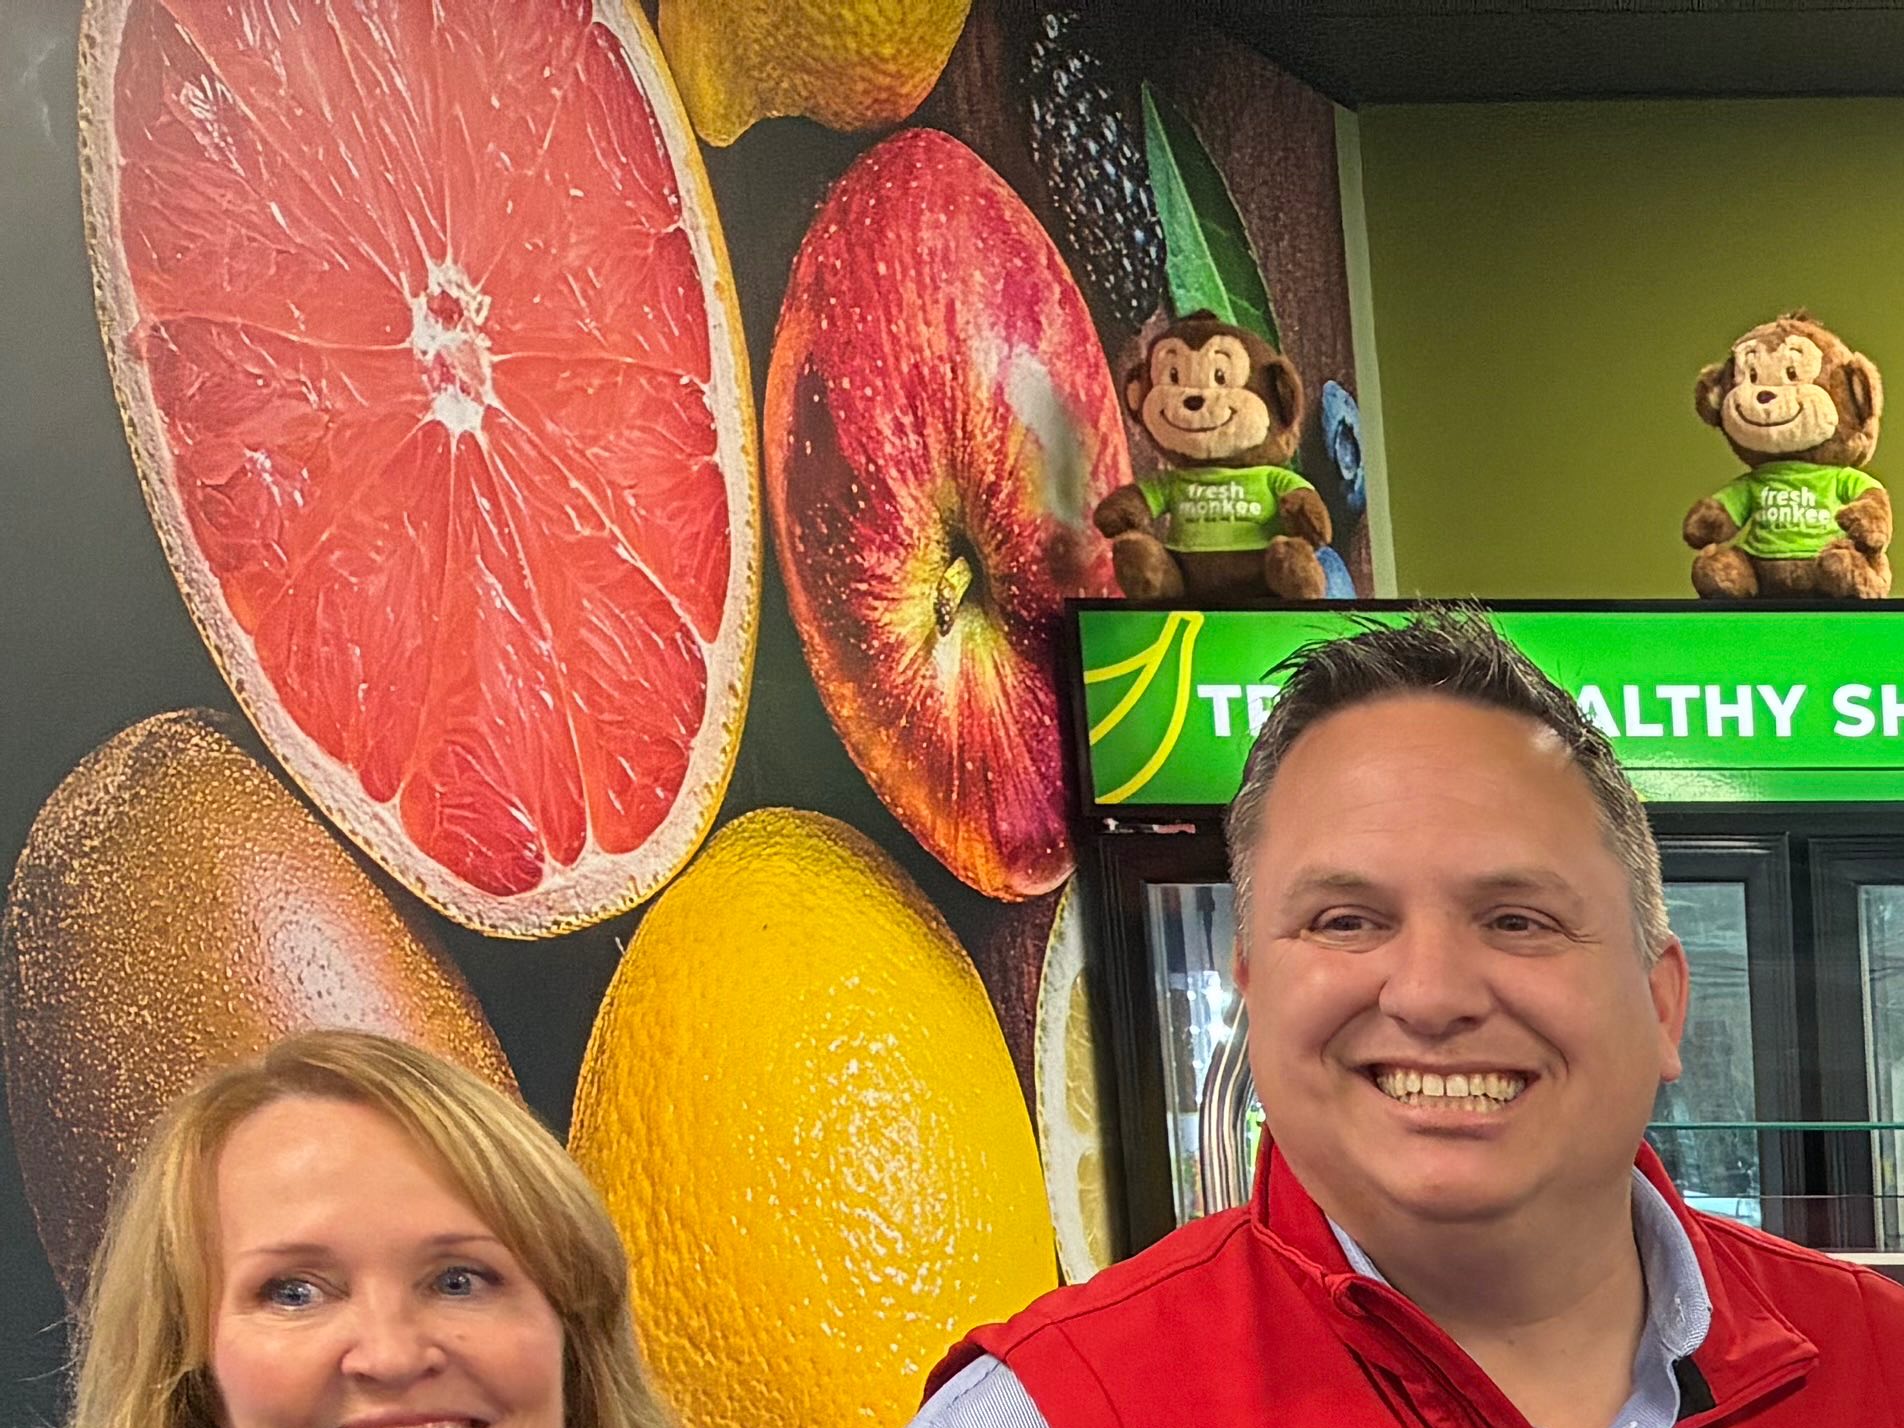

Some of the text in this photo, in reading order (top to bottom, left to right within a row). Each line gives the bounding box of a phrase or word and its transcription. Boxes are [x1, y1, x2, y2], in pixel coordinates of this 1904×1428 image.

[1188, 481, 1244, 500] fresh
[1761, 489, 1815, 508] fresh
[1588, 684, 1799, 737] ALTHY
